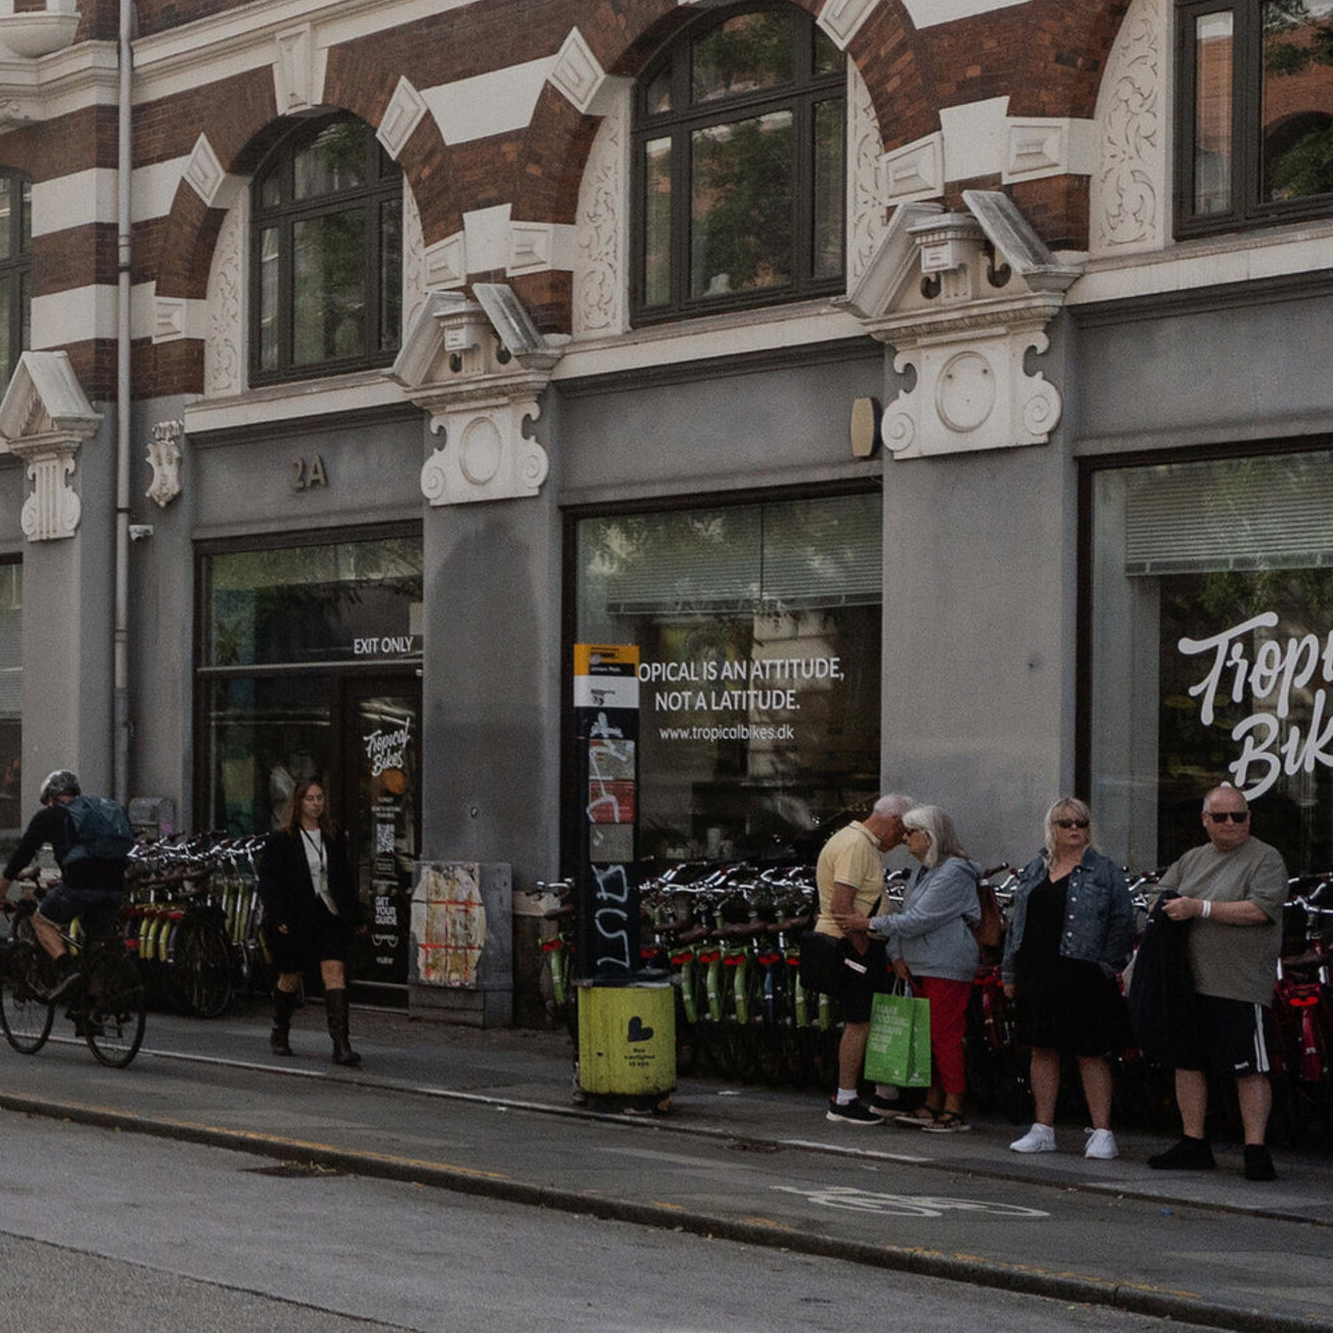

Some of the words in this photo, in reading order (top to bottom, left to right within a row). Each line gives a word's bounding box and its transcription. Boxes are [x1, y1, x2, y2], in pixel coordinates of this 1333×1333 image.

[292, 456, 328, 489] 2A
[354, 638, 379, 654] EXIT
[381, 636, 413, 653] ONLY
[639, 662, 701, 682] OPICAL
[704, 661, 718, 680] IS
[721, 660, 747, 680] AN
[752, 657, 845, 680] ATTITUDE,
[655, 692, 692, 711] NOT
[694, 691, 708, 711] A
[711, 689, 801, 711] LATITUDE.
[659, 724, 795, 742] www.tropicalbikes.dk
